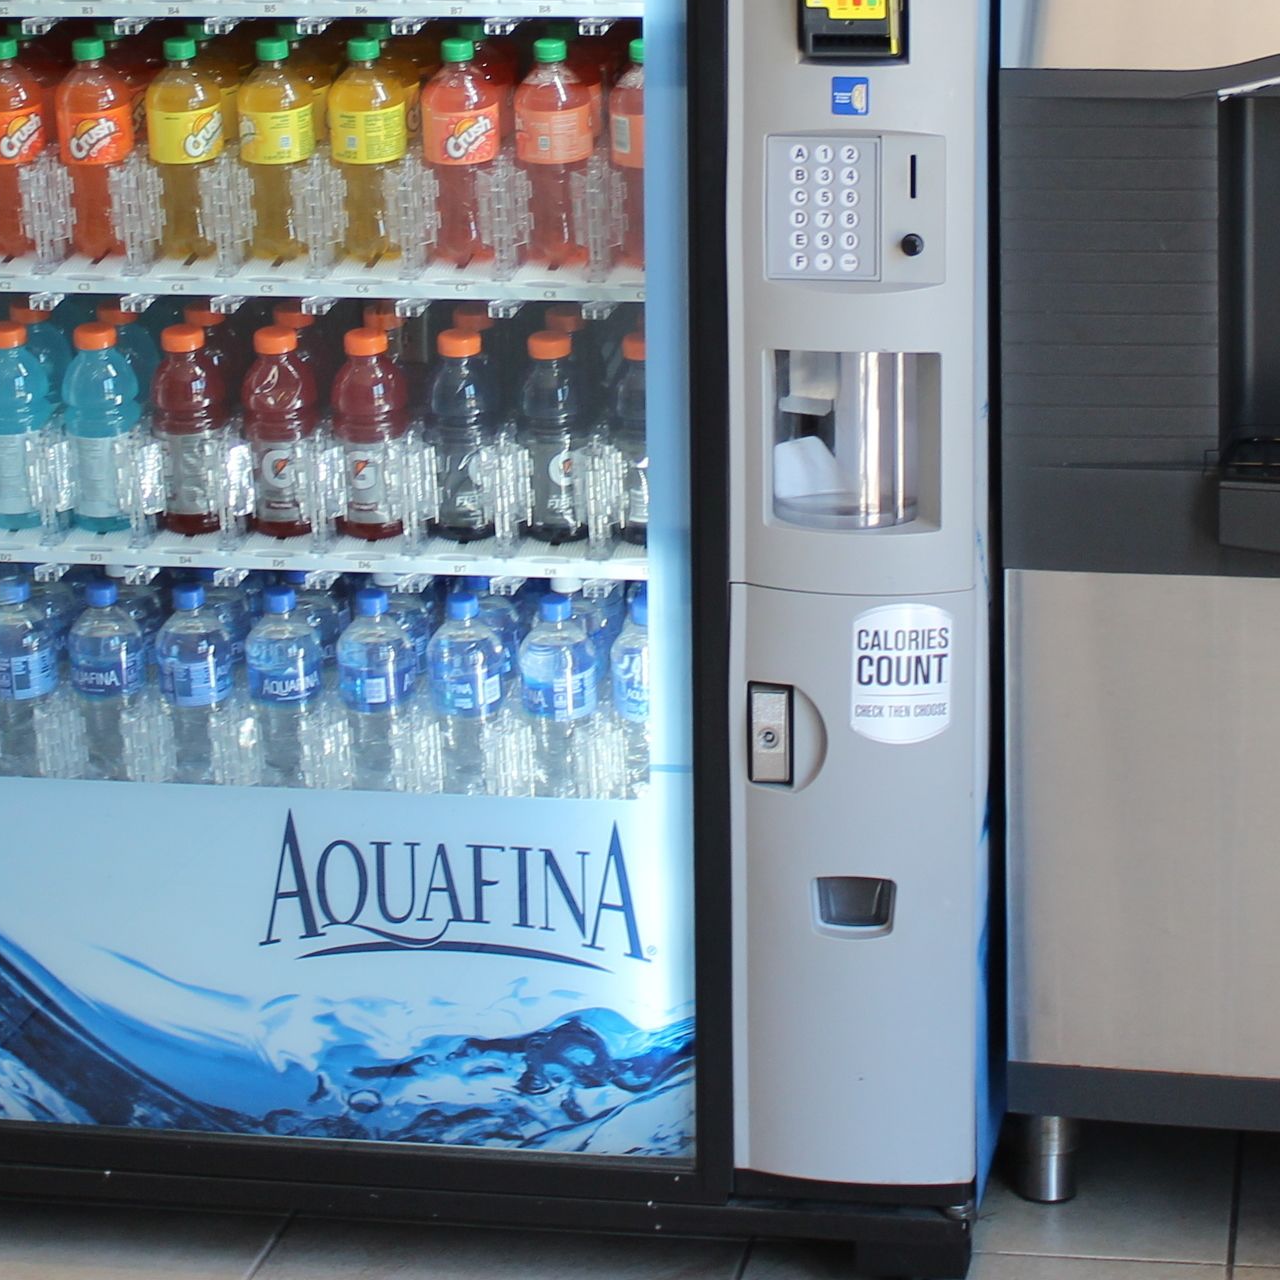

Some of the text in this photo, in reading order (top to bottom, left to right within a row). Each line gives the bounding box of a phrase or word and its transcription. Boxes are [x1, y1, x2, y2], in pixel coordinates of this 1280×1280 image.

[70, 116, 115, 159] Crush
[445, 114, 492, 160] Crush
[795, 148, 855, 159] A 1 2
[795, 170, 855, 181] B 3 4
[795, 191, 855, 202] C 5 6
[795, 213, 855, 224] D 7 8
[795, 235, 805, 246] E
[821, 235, 829, 246] 9
[796, 256, 805, 267] F
[857, 627, 949, 651] CALORIES
[857, 653, 949, 686] COUNT
[855, 702, 948, 718] CHECK THEN CHOOSE
[259, 807, 653, 963] AQUAFINA
